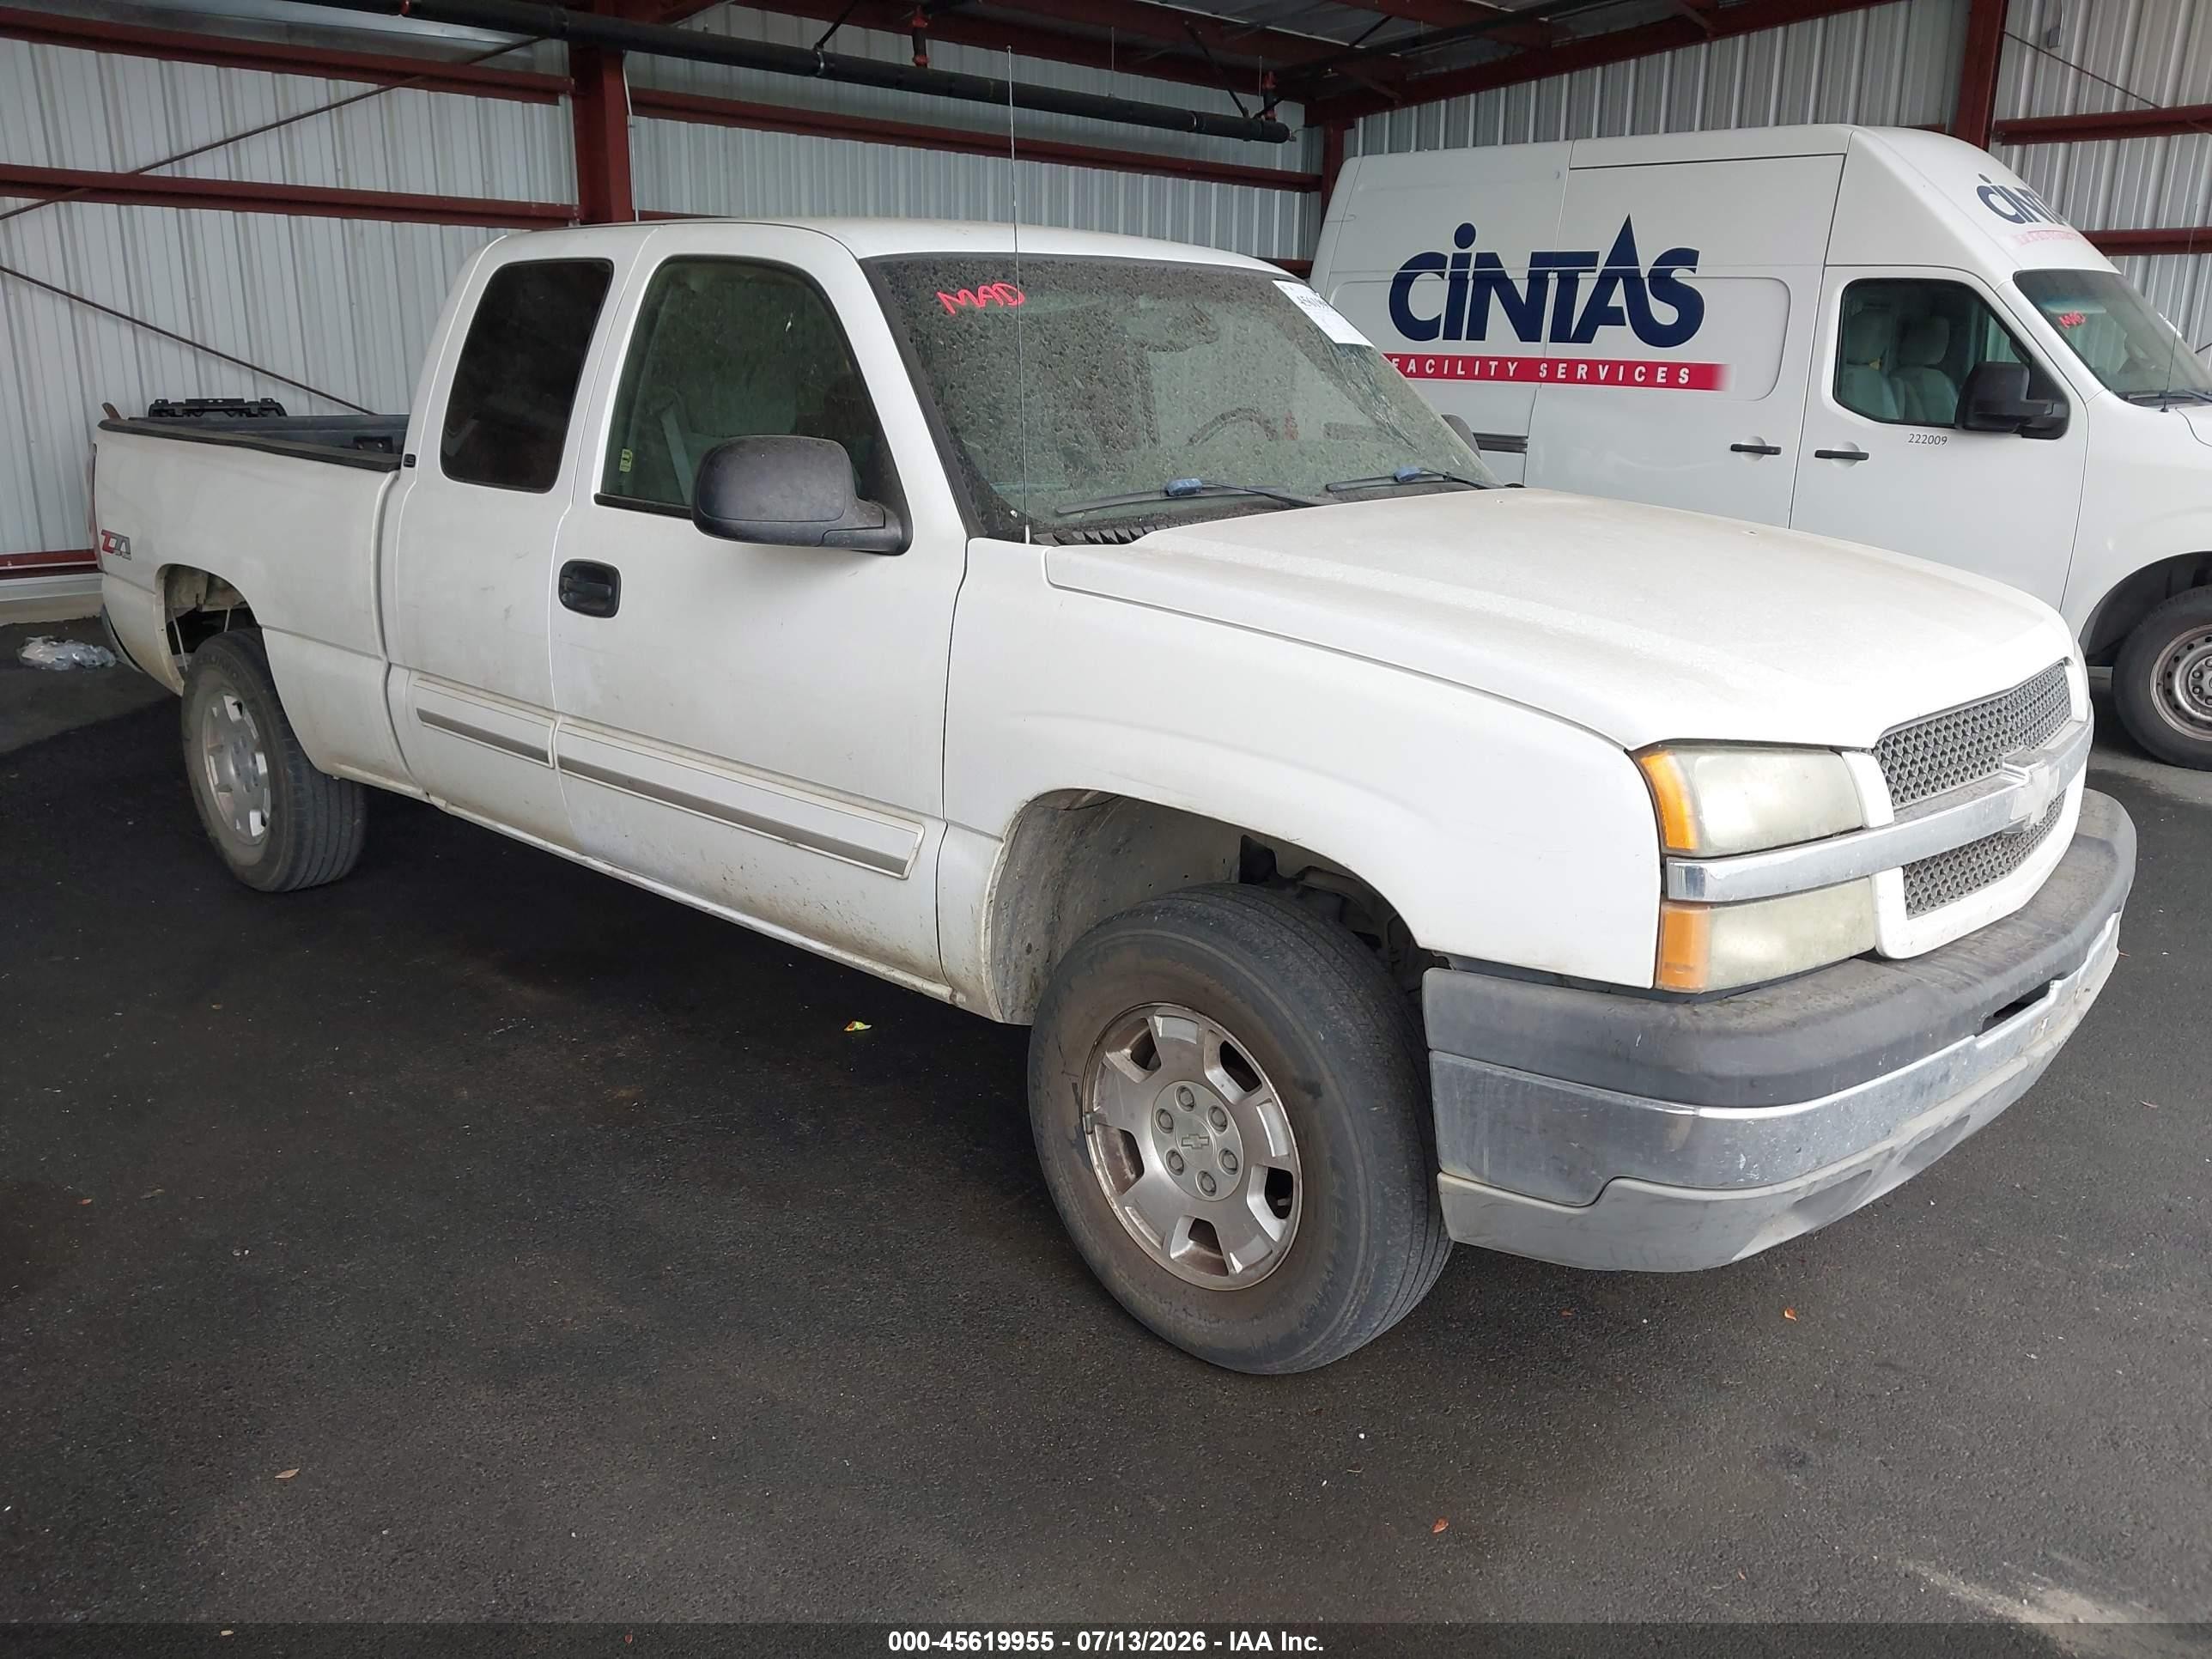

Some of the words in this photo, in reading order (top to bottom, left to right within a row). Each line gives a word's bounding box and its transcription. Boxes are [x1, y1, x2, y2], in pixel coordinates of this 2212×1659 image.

[936, 283, 1025, 315] MAD
[1392, 357, 1517, 376] FACILITY
[1539, 362, 1690, 384] SERVICES
[1908, 433, 1948, 445] 222009
